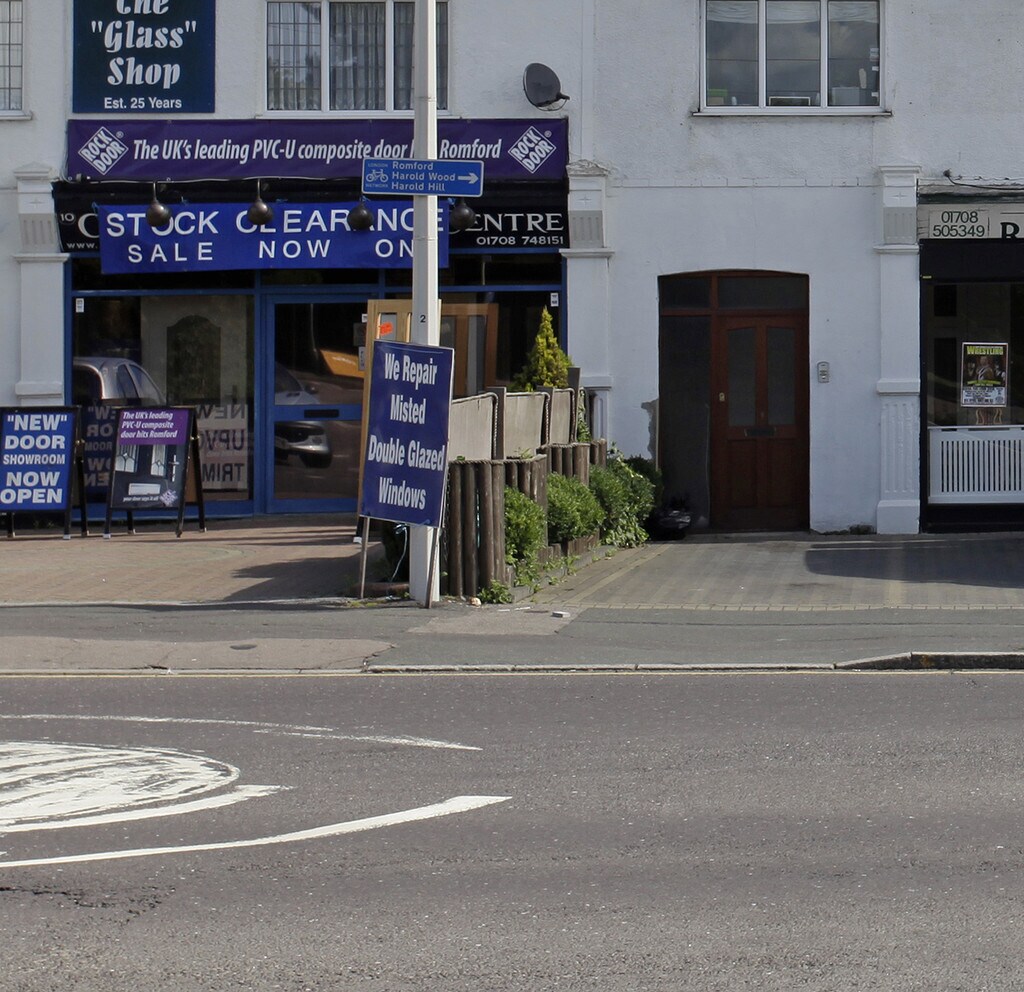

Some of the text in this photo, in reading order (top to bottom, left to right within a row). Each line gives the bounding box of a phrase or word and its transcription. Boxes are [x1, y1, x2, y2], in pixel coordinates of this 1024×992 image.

[91, 20, 197, 53] "Glass"
[107, 56, 181, 89] Shop
[104, 96, 182, 109] Est. 25 Years
[81, 130, 113, 162] ROCK
[133, 139, 159, 160] The
[162, 139, 192, 160] UK's
[194, 139, 250, 164] leading
[252, 139, 296, 160] PVC-U
[298, 139, 372, 163] composite
[373, 139, 408, 158] door
[440, 138, 502, 159] Romford
[510, 129, 541, 161] ROCK
[93, 141, 125, 172] DOOR
[522, 140, 553, 170] DOOR
[392, 161, 434, 171] Romford
[391, 171, 456, 181] Harold Wood
[391, 181, 445, 191] Harold Hill
[450, 212, 564, 234] ENTRE
[941, 211, 979, 223] 01708
[932, 224, 985, 237] 505349
[476, 236, 564, 246] 01708 748151
[127, 238, 414, 263] SALE NOW ON
[419, 314, 426, 323] 2
[384, 352, 400, 381] We
[402, 355, 438, 391] Repair
[122, 411, 135, 419] The
[148, 411, 174, 421] leading
[390, 393, 427, 425] Misted
[7, 414, 67, 431] "NEW"
[141, 421, 174, 430] composite
[4, 434, 65, 450] DOOR
[120, 430, 136, 438] door
[149, 430, 178, 438] Romford
[2, 454, 65, 465] SHOWROOM
[368, 434, 445, 472] Double Glazed
[6, 471, 60, 487] NOW
[0, 488, 62, 504] OPEN
[378, 476, 427, 510] Windows
